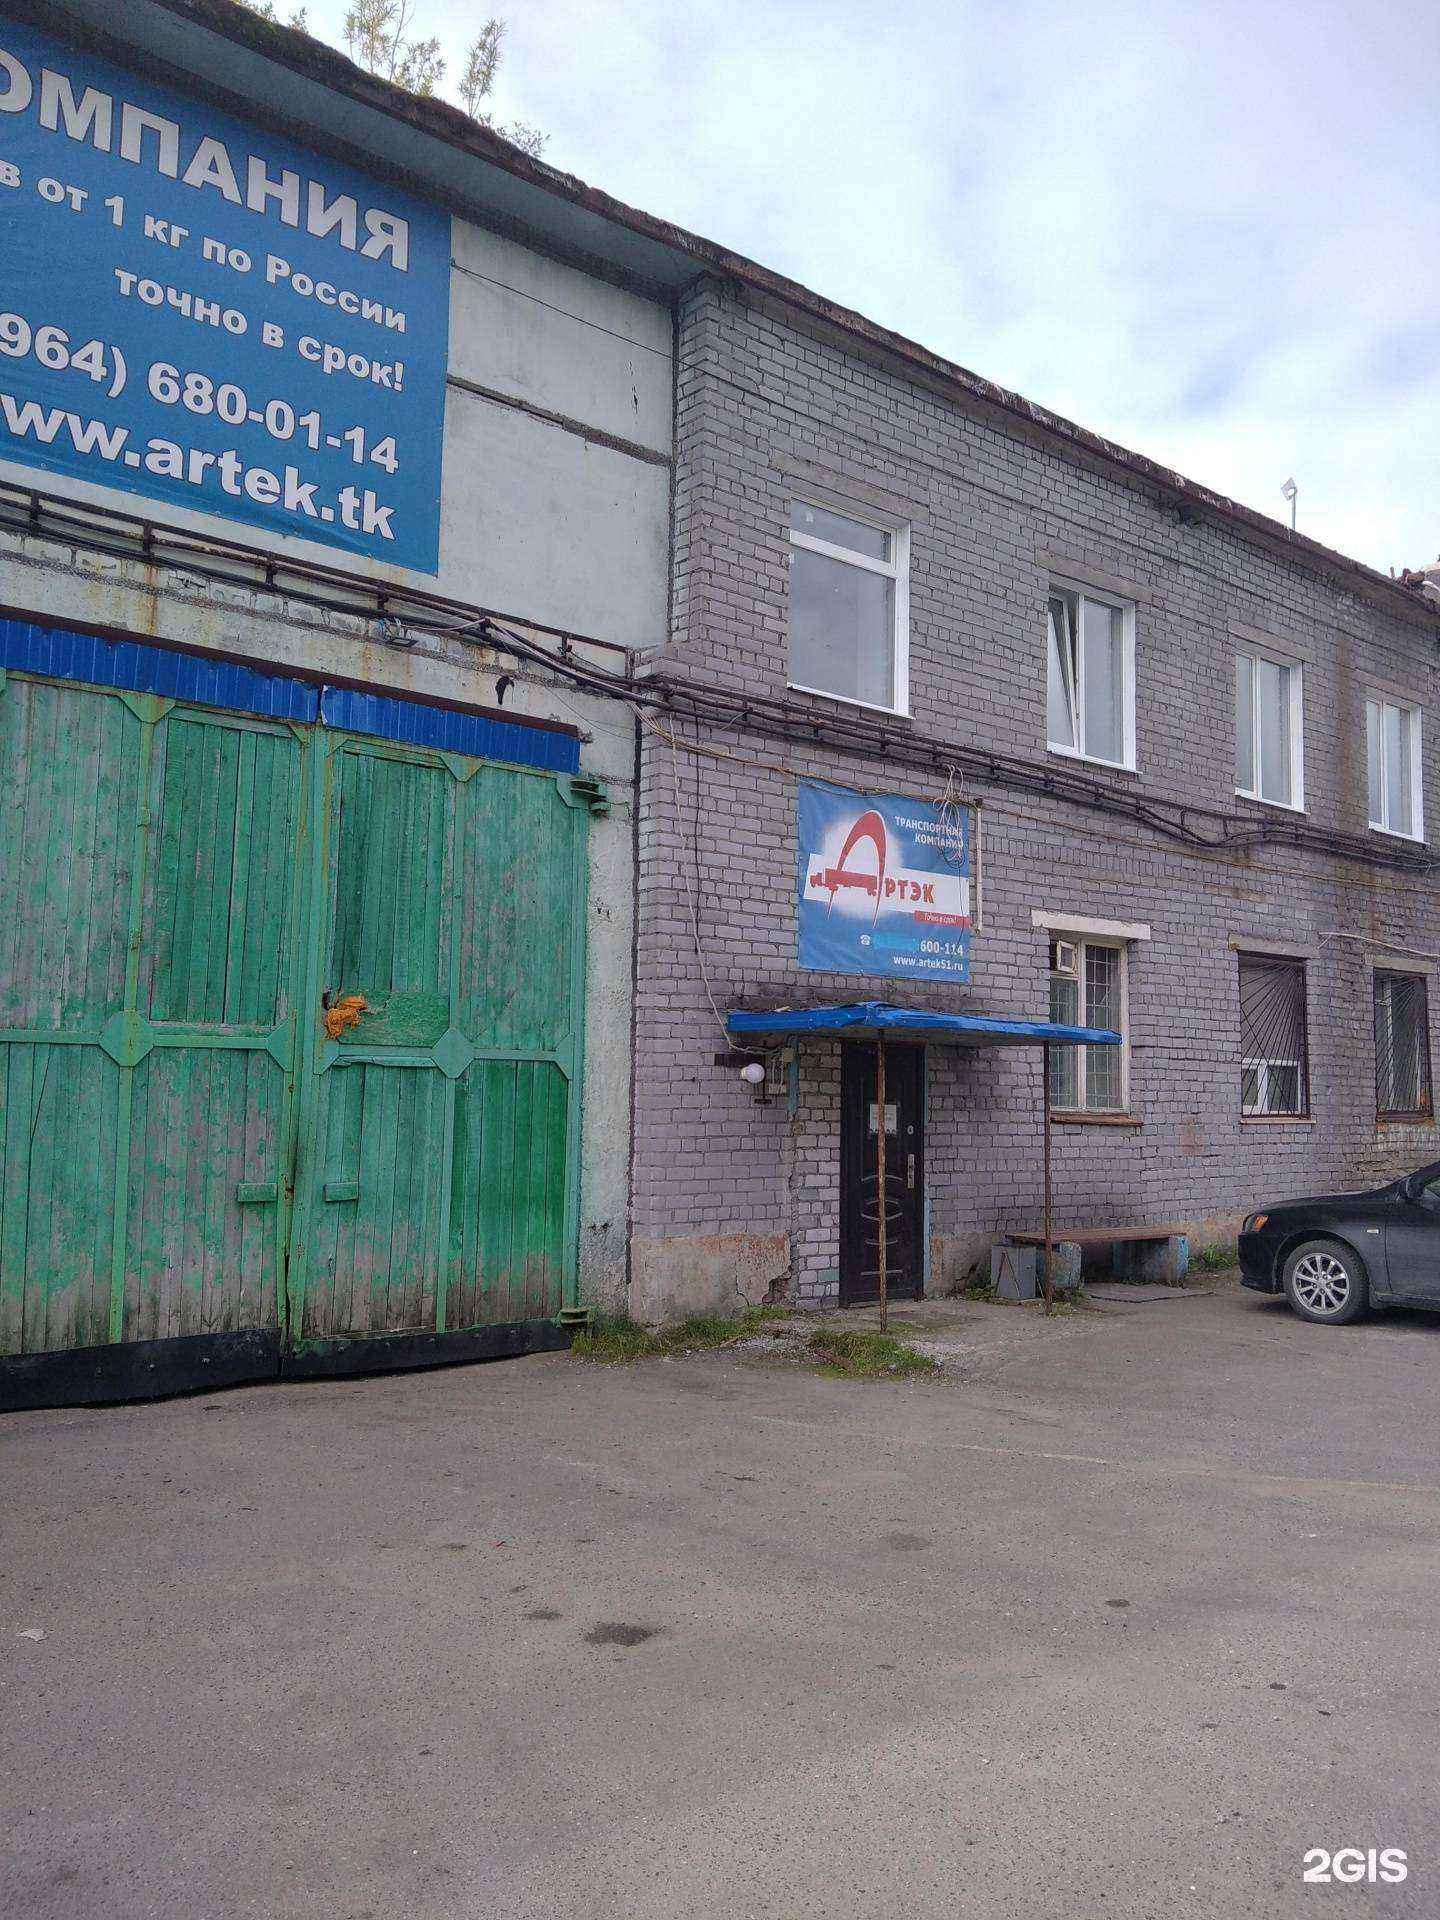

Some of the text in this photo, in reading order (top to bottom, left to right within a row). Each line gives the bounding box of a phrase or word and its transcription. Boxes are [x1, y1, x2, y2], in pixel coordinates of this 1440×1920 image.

[37, 177, 89, 212] от
[104, 195, 125, 228] 1
[144, 214, 189, 248] кг
[203, 236, 252, 273] по
[265, 253, 406, 333] России
[115, 268, 404, 393] точно в срок!
[147, 361, 400, 475] 680-01-14
[893, 956, 964, 971] www.artek51.ru
[920, 939, 964, 956] 600-114
